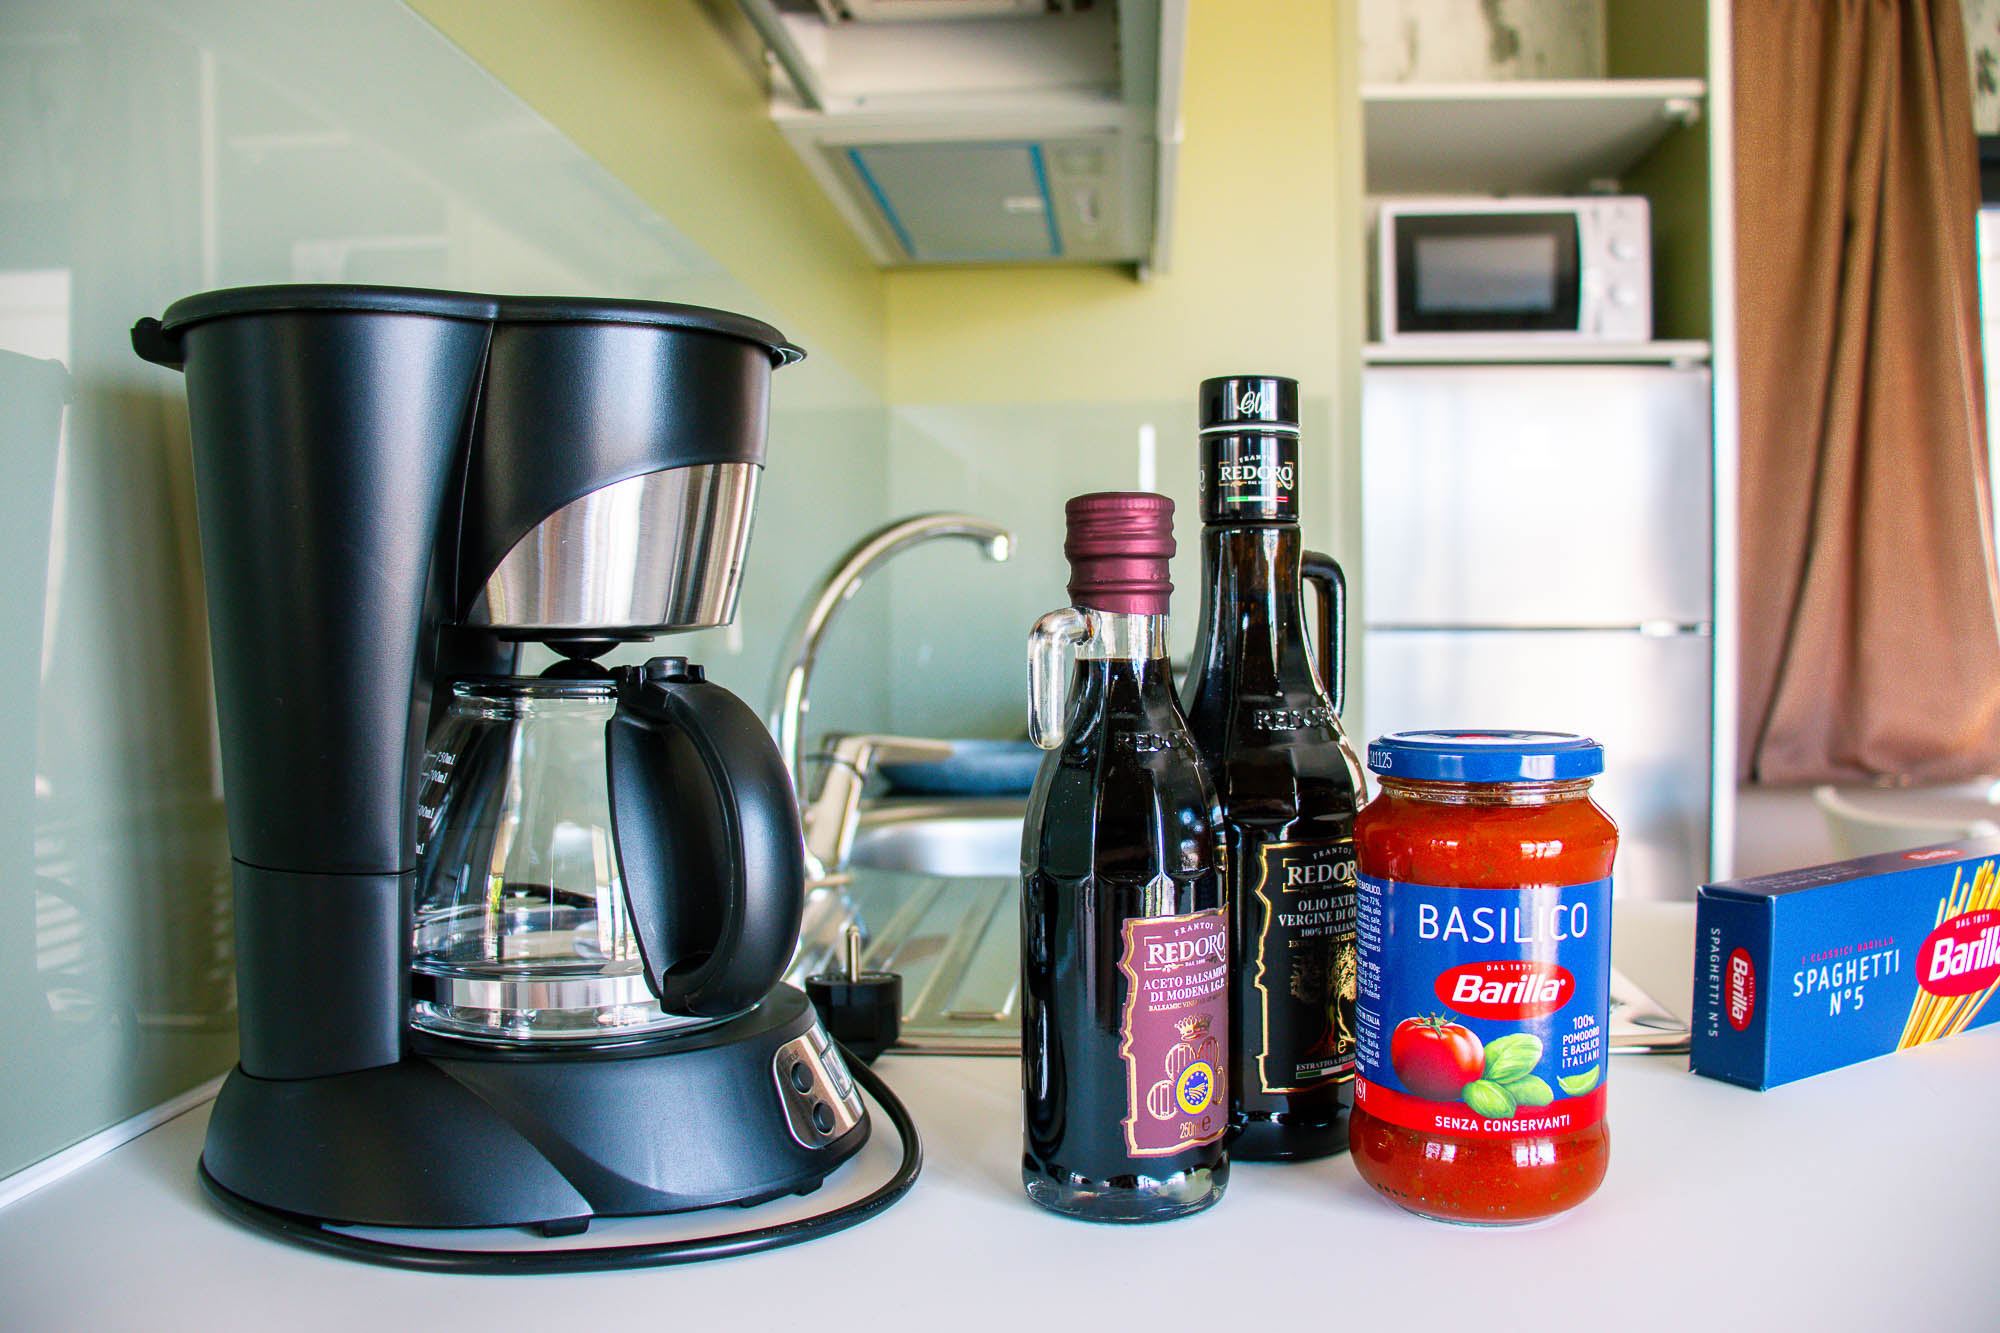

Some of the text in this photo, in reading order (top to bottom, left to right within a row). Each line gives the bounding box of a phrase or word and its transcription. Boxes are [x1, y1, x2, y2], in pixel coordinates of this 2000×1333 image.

[1287, 860, 1359, 886] REDOR
[1298, 898, 1329, 912] OLIO
[1331, 894, 1356, 909] EXTR
[1278, 911, 1333, 927] VERGINE
[1336, 909, 1346, 921] DI
[1419, 902, 1588, 944] BASILICO
[1174, 922, 1214, 937] FRANTOI
[1301, 927, 1322, 937] 100%
[1325, 921, 1357, 935] ITALIAN
[1147, 931, 1226, 965] REDORO
[1810, 945, 1853, 963] CLASSICI
[1857, 936, 1894, 953] BARILLA
[1486, 964, 1505, 972] DAL
[1709, 927, 1721, 1006] SPAGHETTI
[1793, 949, 1900, 997] SPAGHETTI
[1143, 964, 1228, 991] ACETO BALSAMICO
[1150, 991, 1165, 1003] DI
[1166, 984, 1210, 1001] MODENA
[1451, 974, 1562, 1004] Barilla
[1732, 956, 1749, 1020] Barilla
[1149, 1002, 1182, 1012] BALSAMIC
[1573, 1014, 1595, 1030] 100%
[1563, 1026, 1600, 1045] POMODORO
[1562, 1037, 1600, 1057] E BASILICO
[1562, 1048, 1600, 1069] ITALIANI
[1434, 1113, 1571, 1132] SENZA CONSERVANTI
